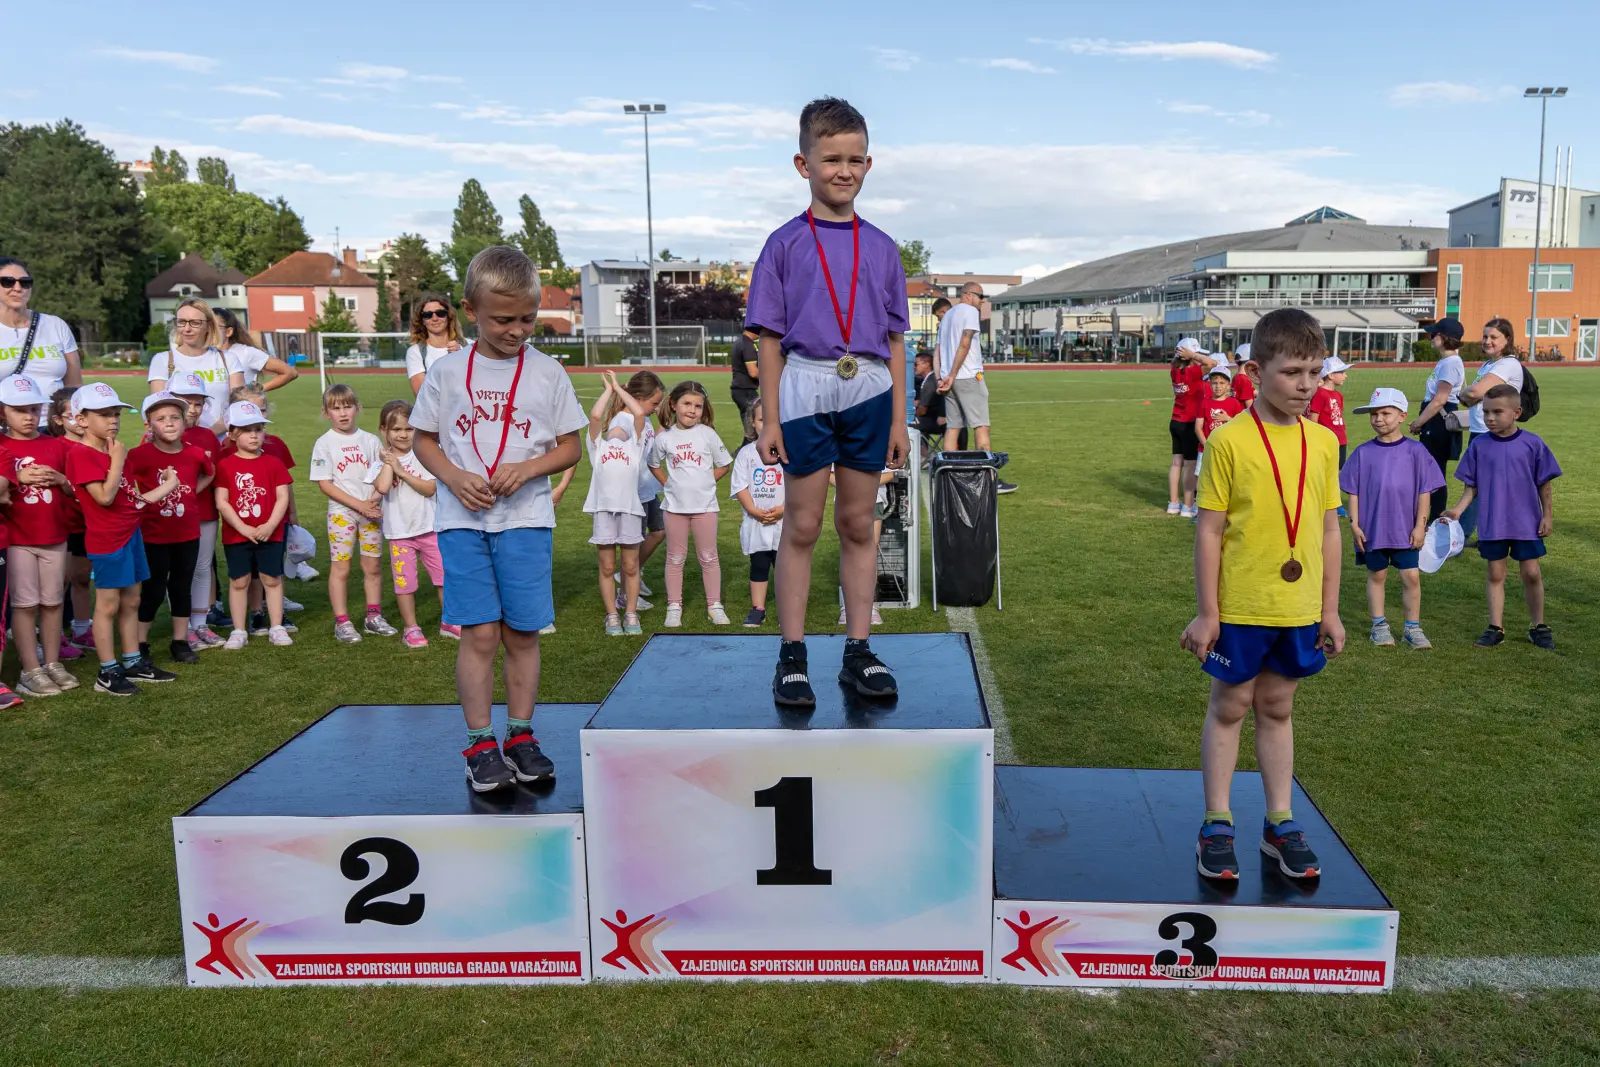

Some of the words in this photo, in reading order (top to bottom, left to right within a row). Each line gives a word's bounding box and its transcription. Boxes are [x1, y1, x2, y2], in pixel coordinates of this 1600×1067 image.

[1510, 189, 1537, 203] TTS
[455, 402, 532, 439] BAJKA
[336, 453, 371, 473] BAJKA
[601, 451, 630, 466] BAJKA
[671, 451, 702, 469] BAJKA
[754, 776, 833, 886] 1
[340, 836, 426, 926] 2
[1154, 911, 1219, 979] 3
[275, 963, 343, 976] ZAJEDNICA
[346, 962, 411, 975] SPORTSKIH
[414, 962, 464, 974] UDRUGA
[466, 961, 507, 974] GRADA
[510, 958, 577, 973] VARAŽDINA
[681, 959, 747, 972] ZAJEDNICA
[750, 959, 814, 972] SPORTSKIH
[817, 959, 866, 972] UDRUGA
[869, 959, 909, 972] GRADA
[912, 957, 979, 972] VARAŽDINA
[1080, 962, 1146, 976] ZAJEDNICA
[1150, 964, 1214, 978] SPORTSKIH
[1217, 965, 1266, 979] UDRUGA
[1269, 967, 1310, 980] GRADA
[1313, 967, 1380, 982] VARAŽDINA
